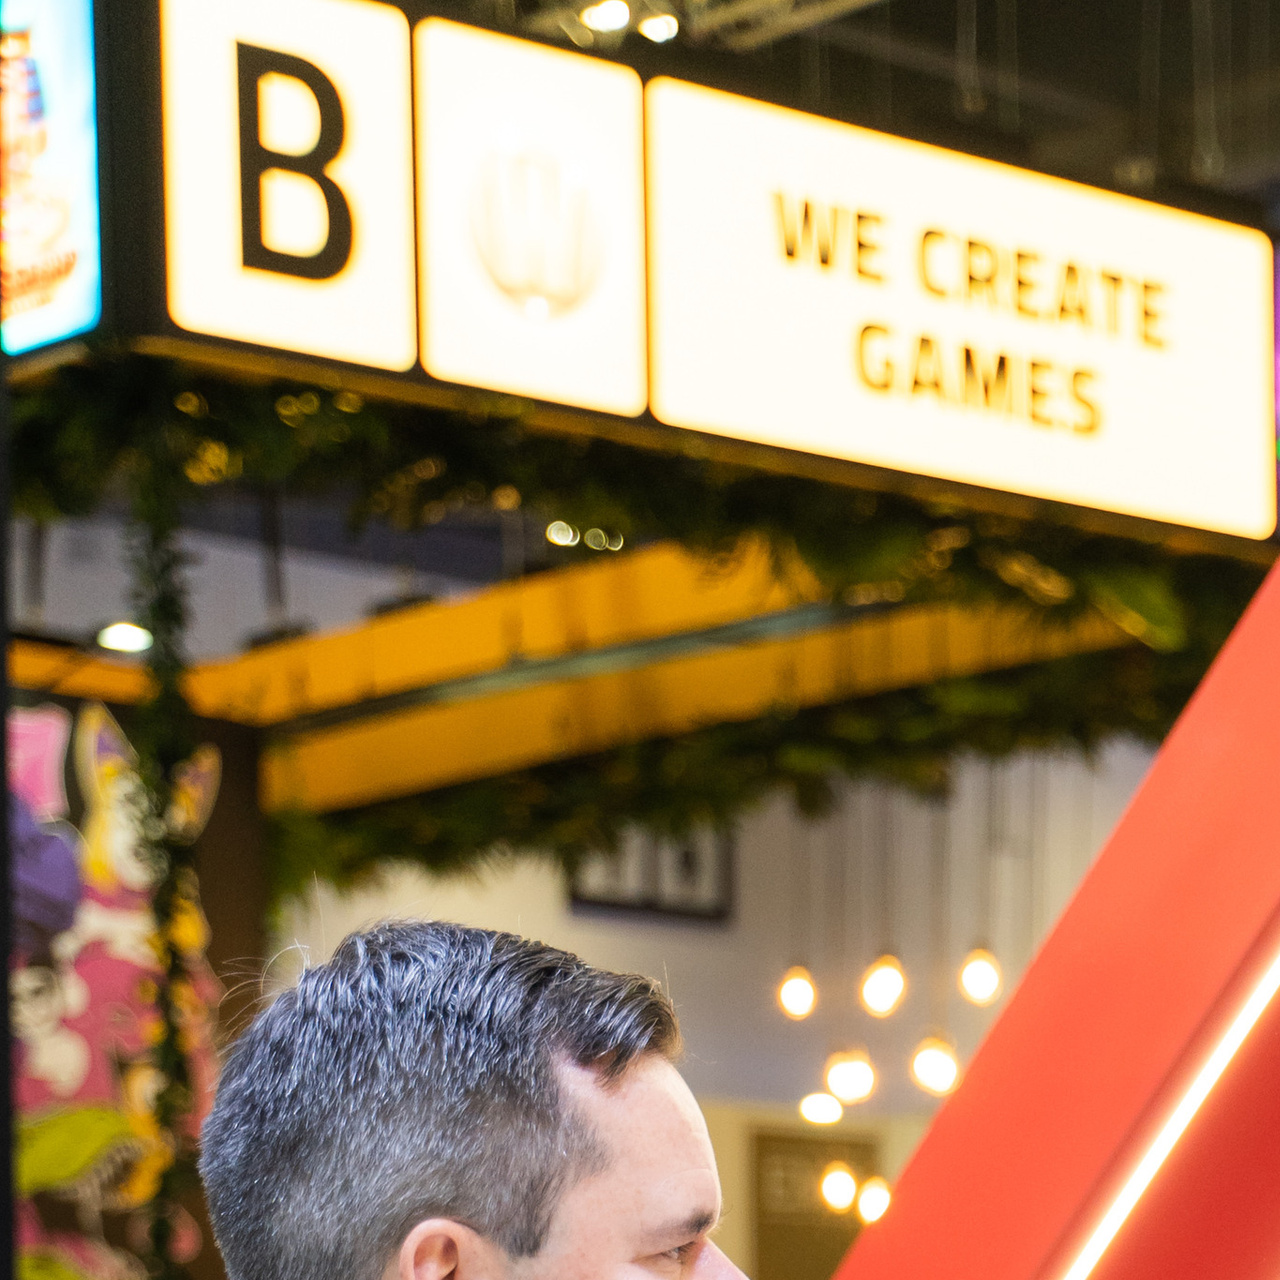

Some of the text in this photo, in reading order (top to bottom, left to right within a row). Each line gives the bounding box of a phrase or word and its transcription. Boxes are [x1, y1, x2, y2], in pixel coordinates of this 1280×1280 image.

[236, 41, 354, 280] B
[772, 188, 1173, 352] WE CREATE
[853, 322, 1106, 440] GAMES
